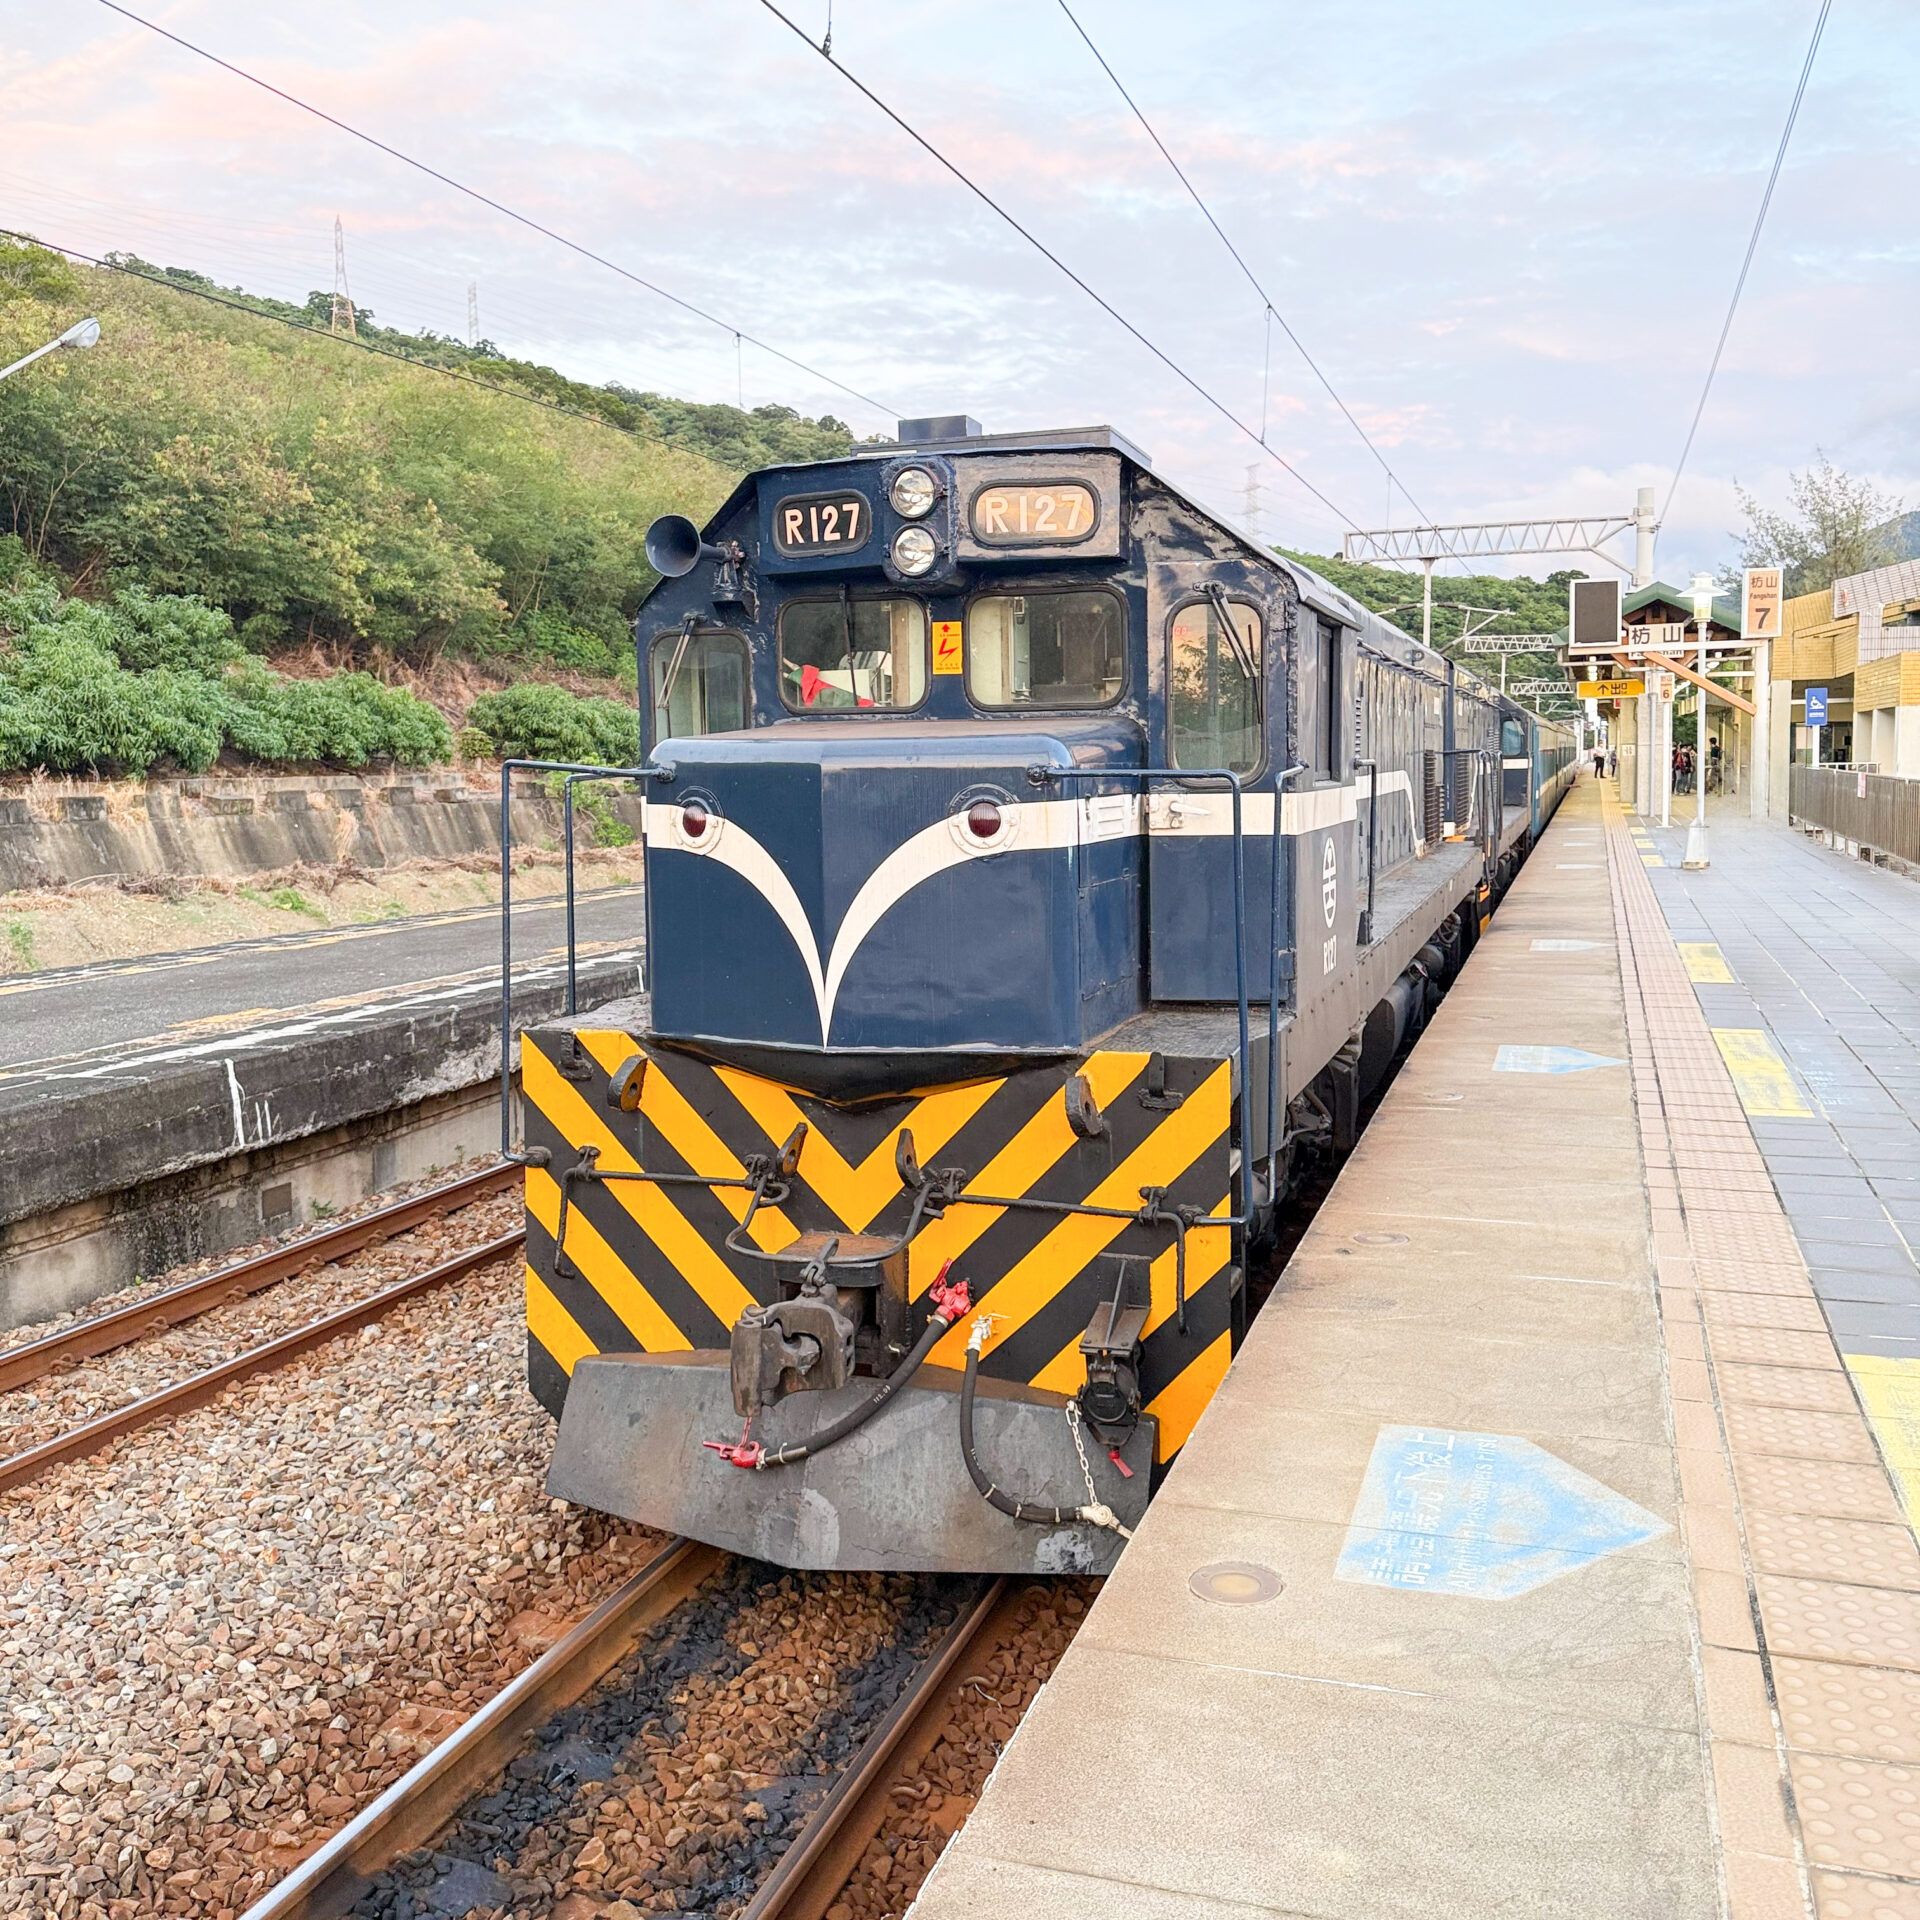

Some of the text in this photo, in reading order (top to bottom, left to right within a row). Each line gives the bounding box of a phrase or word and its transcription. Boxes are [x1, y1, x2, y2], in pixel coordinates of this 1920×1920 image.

[785, 502, 860, 545] R127
[984, 493, 1083, 534] R127
[1751, 576, 1777, 588] 枋山
[1755, 607, 1771, 629] 7
[1631, 625, 1681, 644] 枋山
[1611, 682, 1628, 695] 出口
[1662, 689, 1670, 699] 6
[1323, 934, 1337, 976] R127
[1463, 1463, 1497, 1527] Passengers
